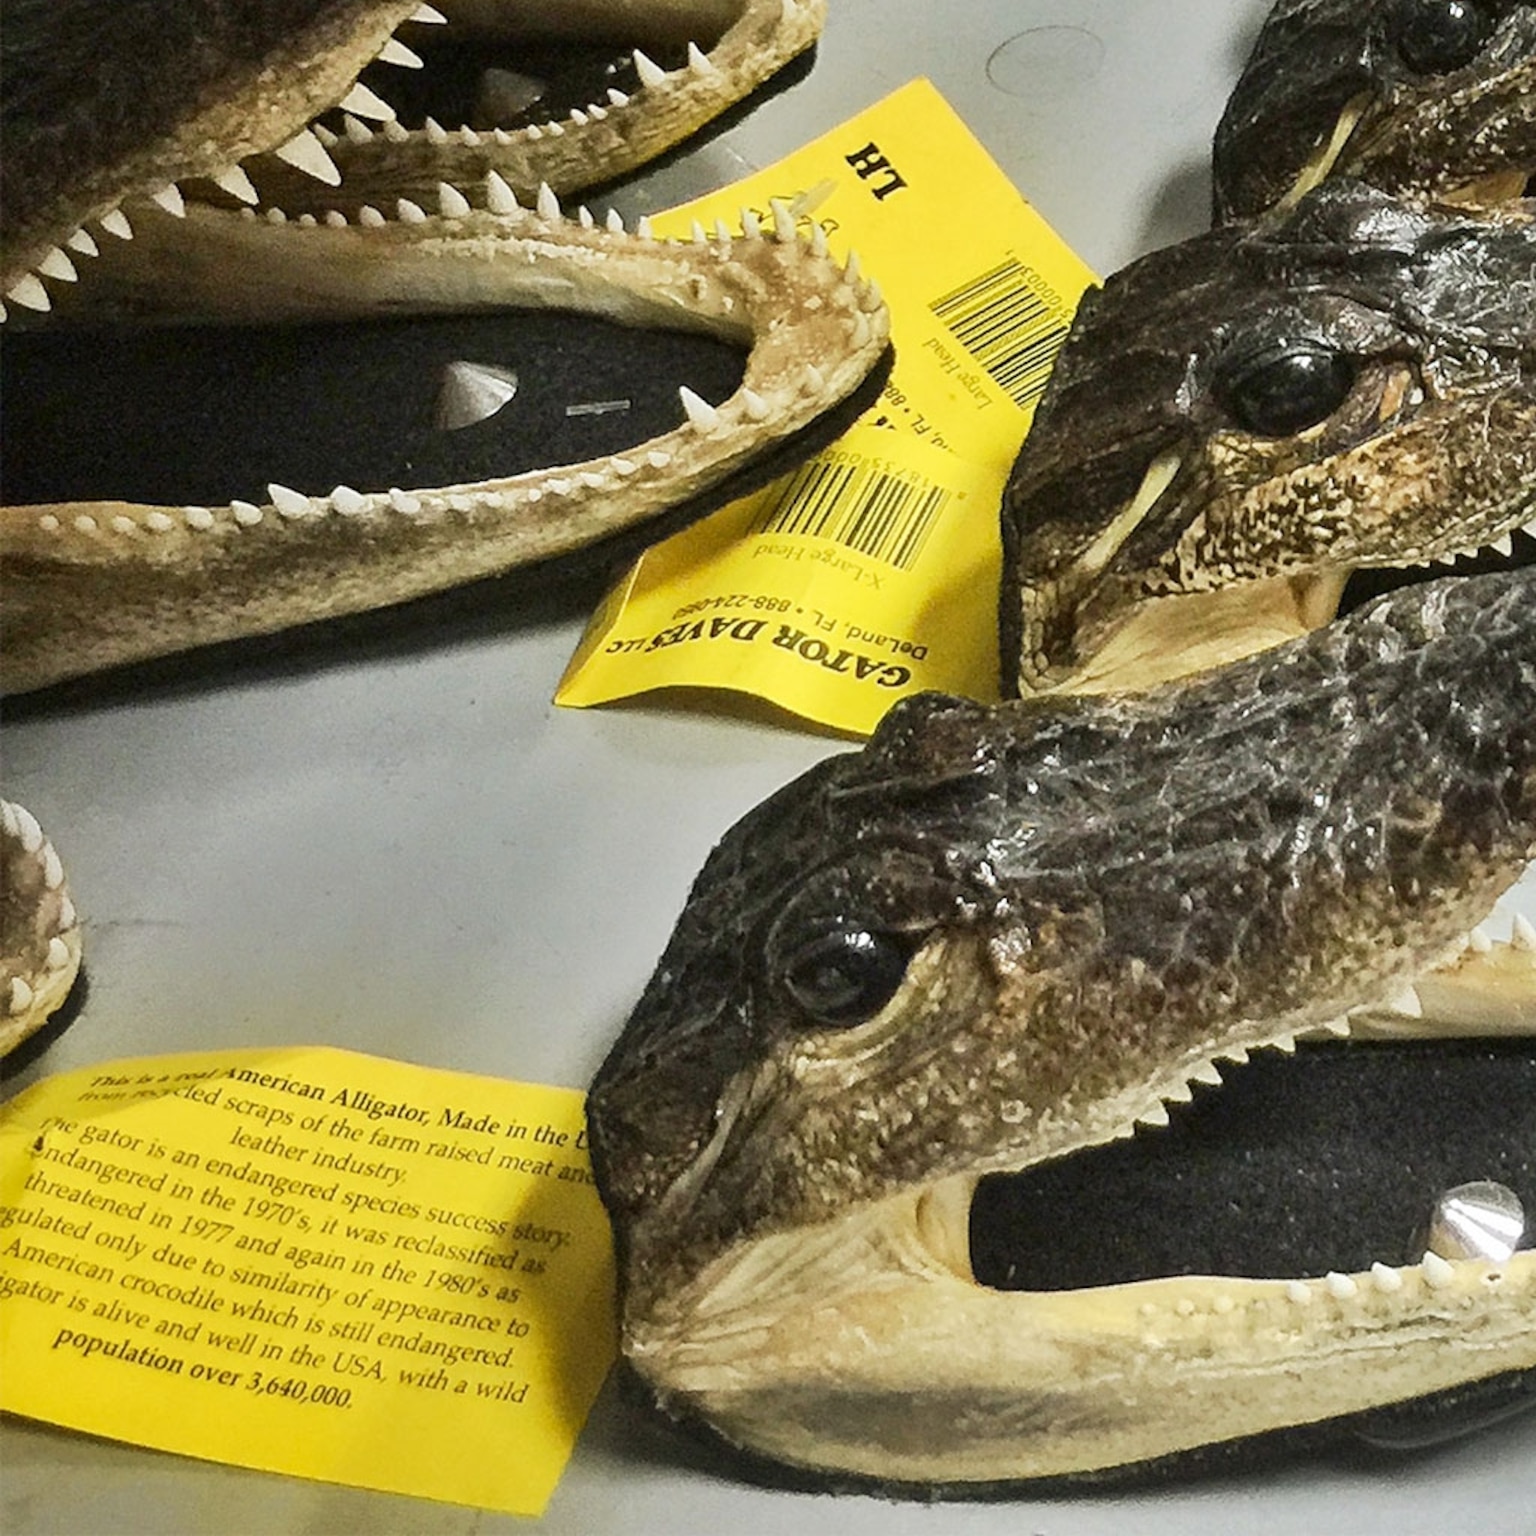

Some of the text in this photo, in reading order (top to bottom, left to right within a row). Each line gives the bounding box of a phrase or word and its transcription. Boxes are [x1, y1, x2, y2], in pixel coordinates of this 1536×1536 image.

[843, 140, 908, 202] LH
[920, 336, 994, 411] Large Head
[909, 412, 932, 435] FL
[750, 539, 886, 591] X-Large Head
[642, 615, 912, 692] GATOR DAVES
[810, 608, 838, 632] FL
[843, 621, 929, 661] DeLand,
[221, 1095, 555, 1177] scraps of the farm raised meat
[222, 1066, 326, 1101] American
[329, 1087, 431, 1127] Alligator,
[437, 1107, 501, 1135] Made
[504, 1119, 528, 1140] in
[532, 1123, 569, 1148] the
[227, 1124, 309, 1162] leather
[77, 1124, 144, 1152] gator
[144, 1136, 168, 1160] is
[170, 1149, 201, 1169] an
[204, 1157, 340, 1202] endangered
[339, 1190, 422, 1220] species
[423, 1206, 510, 1238] success
[23, 1169, 522, 1304] threatened in 1977 and again in the 1980's as
[168, 1178, 194, 1201] in
[199, 1184, 237, 1212] the
[318, 1214, 339, 1235] it
[344, 1224, 389, 1246] was
[392, 1233, 519, 1273] reclassified
[519, 1254, 548, 1277] as
[0, 1235, 514, 1369] American crocodile which is still endangered.
[93, 1230, 530, 1339] only due to similarity of appearance to
[50, 1327, 352, 1409] population over 3,640,000.
[65, 1288, 530, 1404] is alive and well in the USA, with a wild
